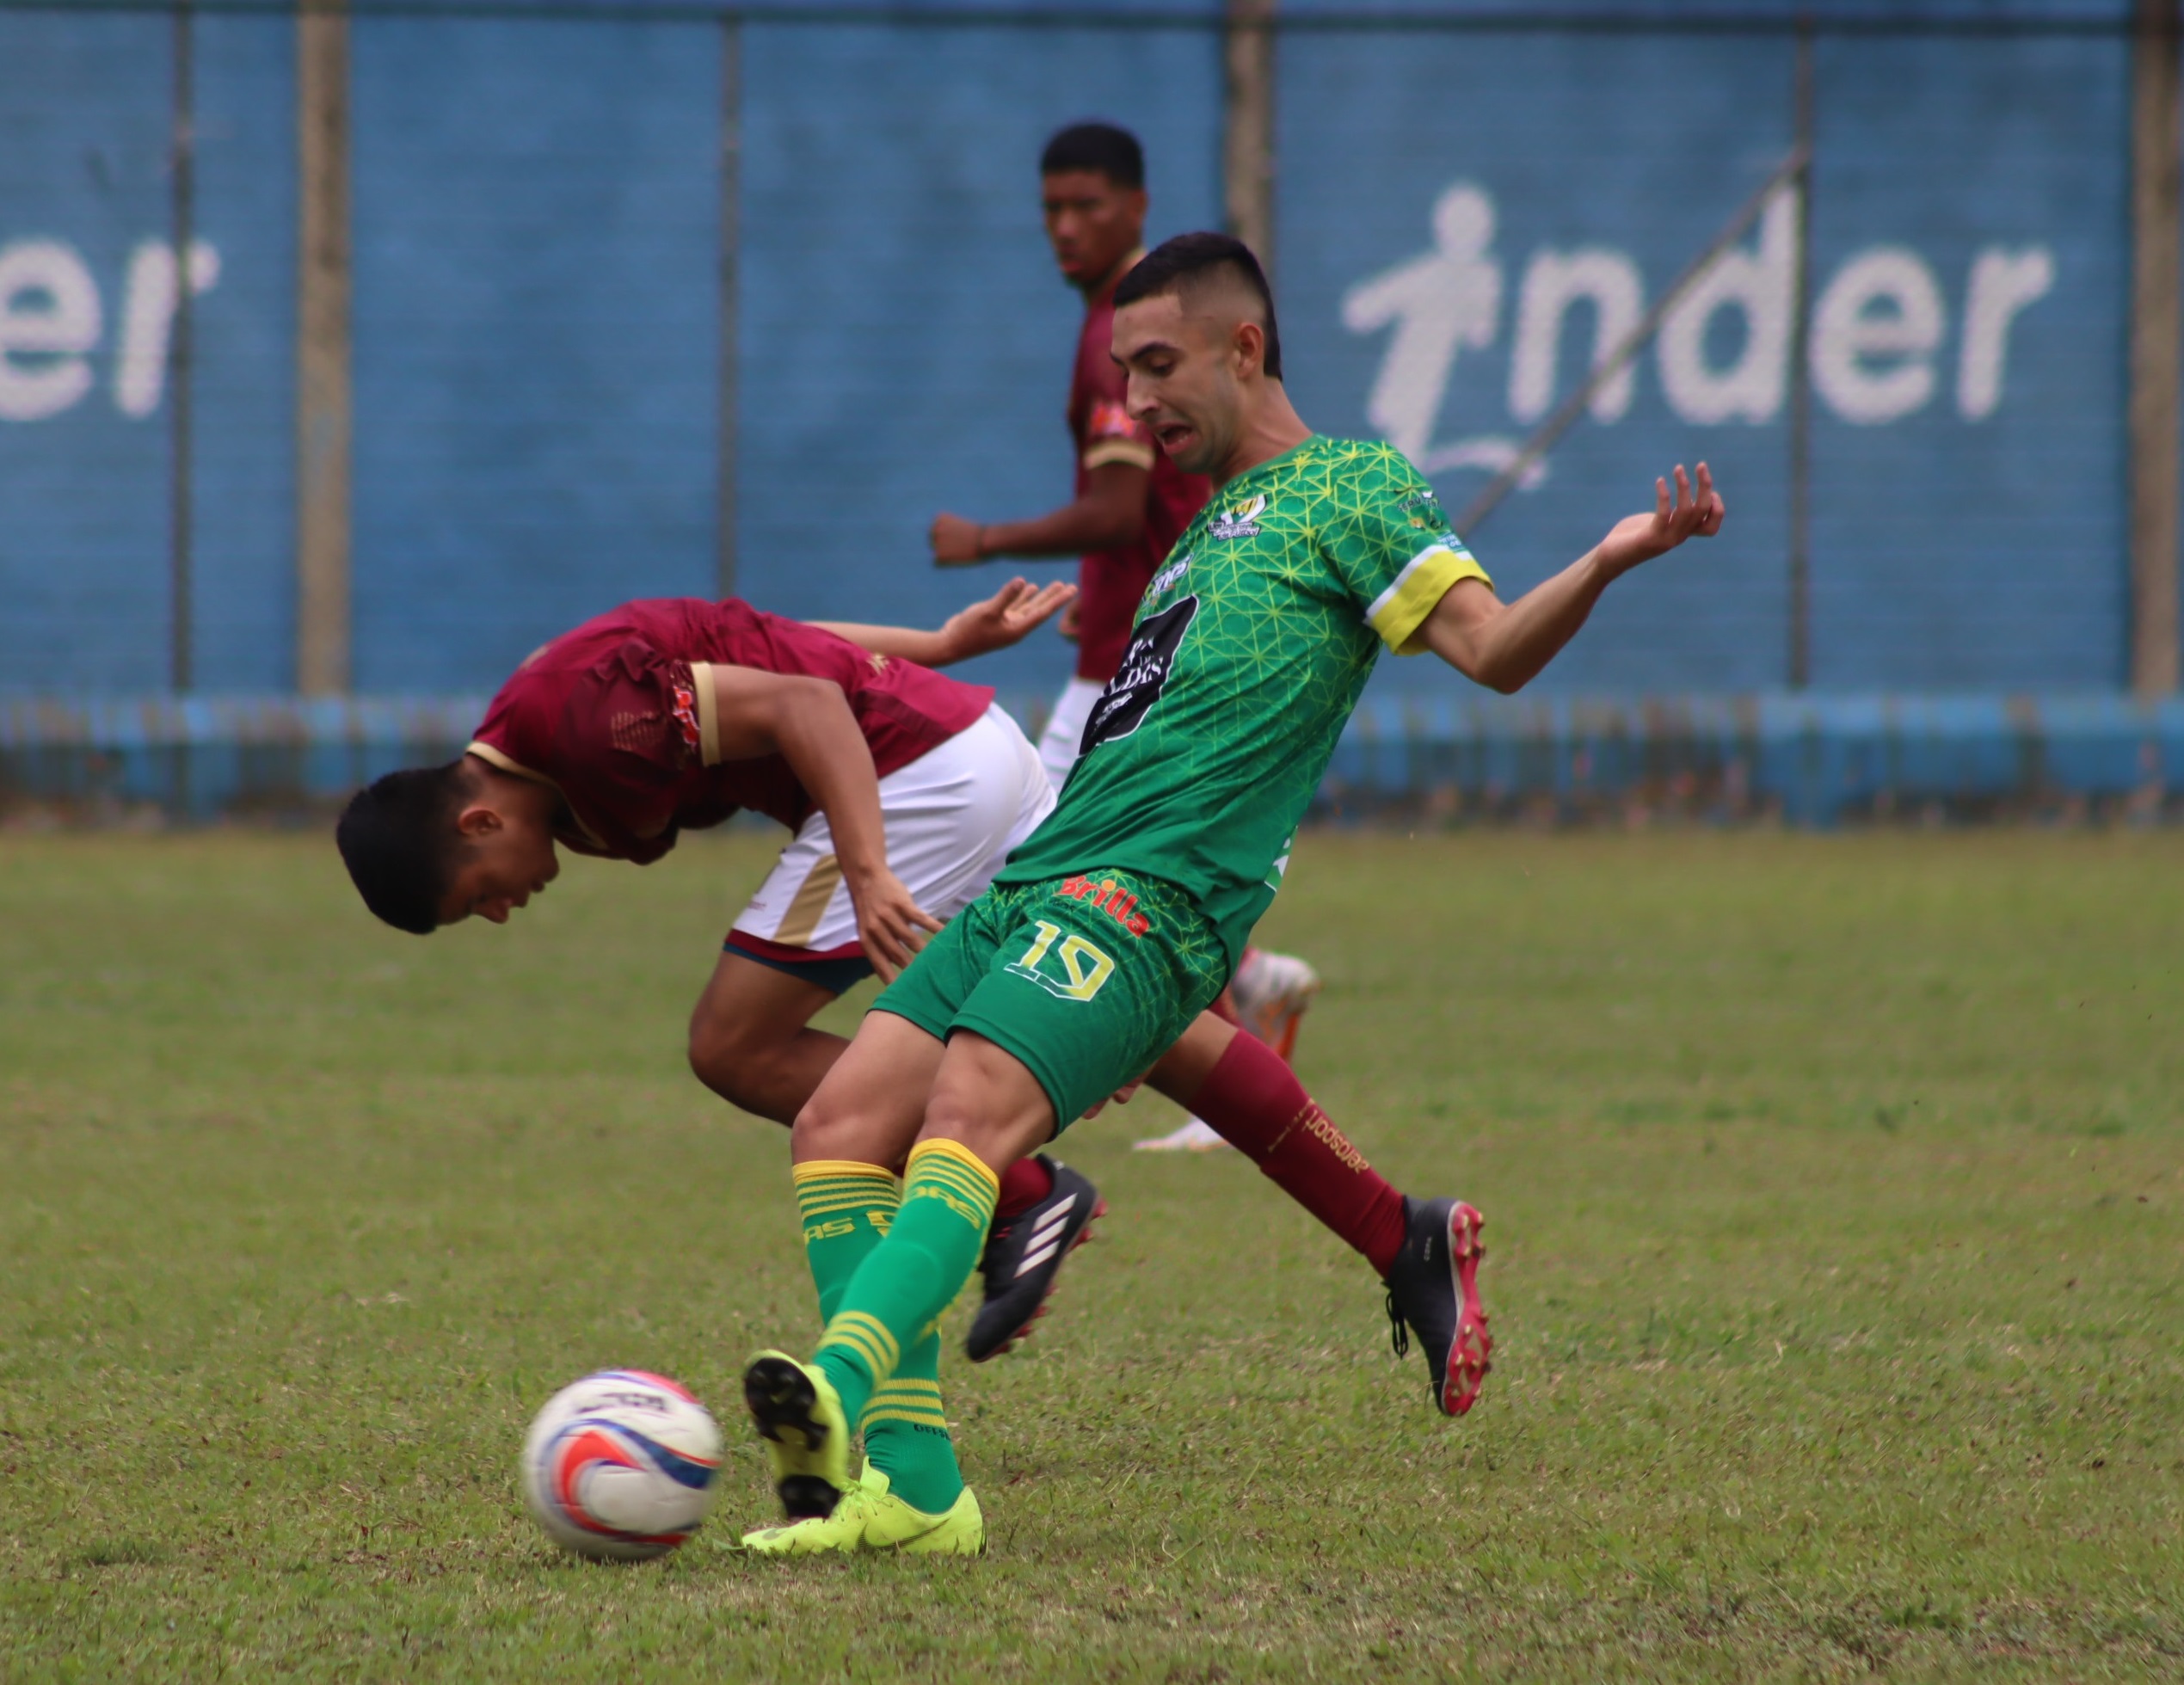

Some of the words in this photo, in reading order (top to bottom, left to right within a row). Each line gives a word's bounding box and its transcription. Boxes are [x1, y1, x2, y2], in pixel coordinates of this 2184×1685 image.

[1340, 181, 2054, 487] inder
[1055, 874, 1150, 938] Brilla
[1003, 919, 1116, 1002] 19
